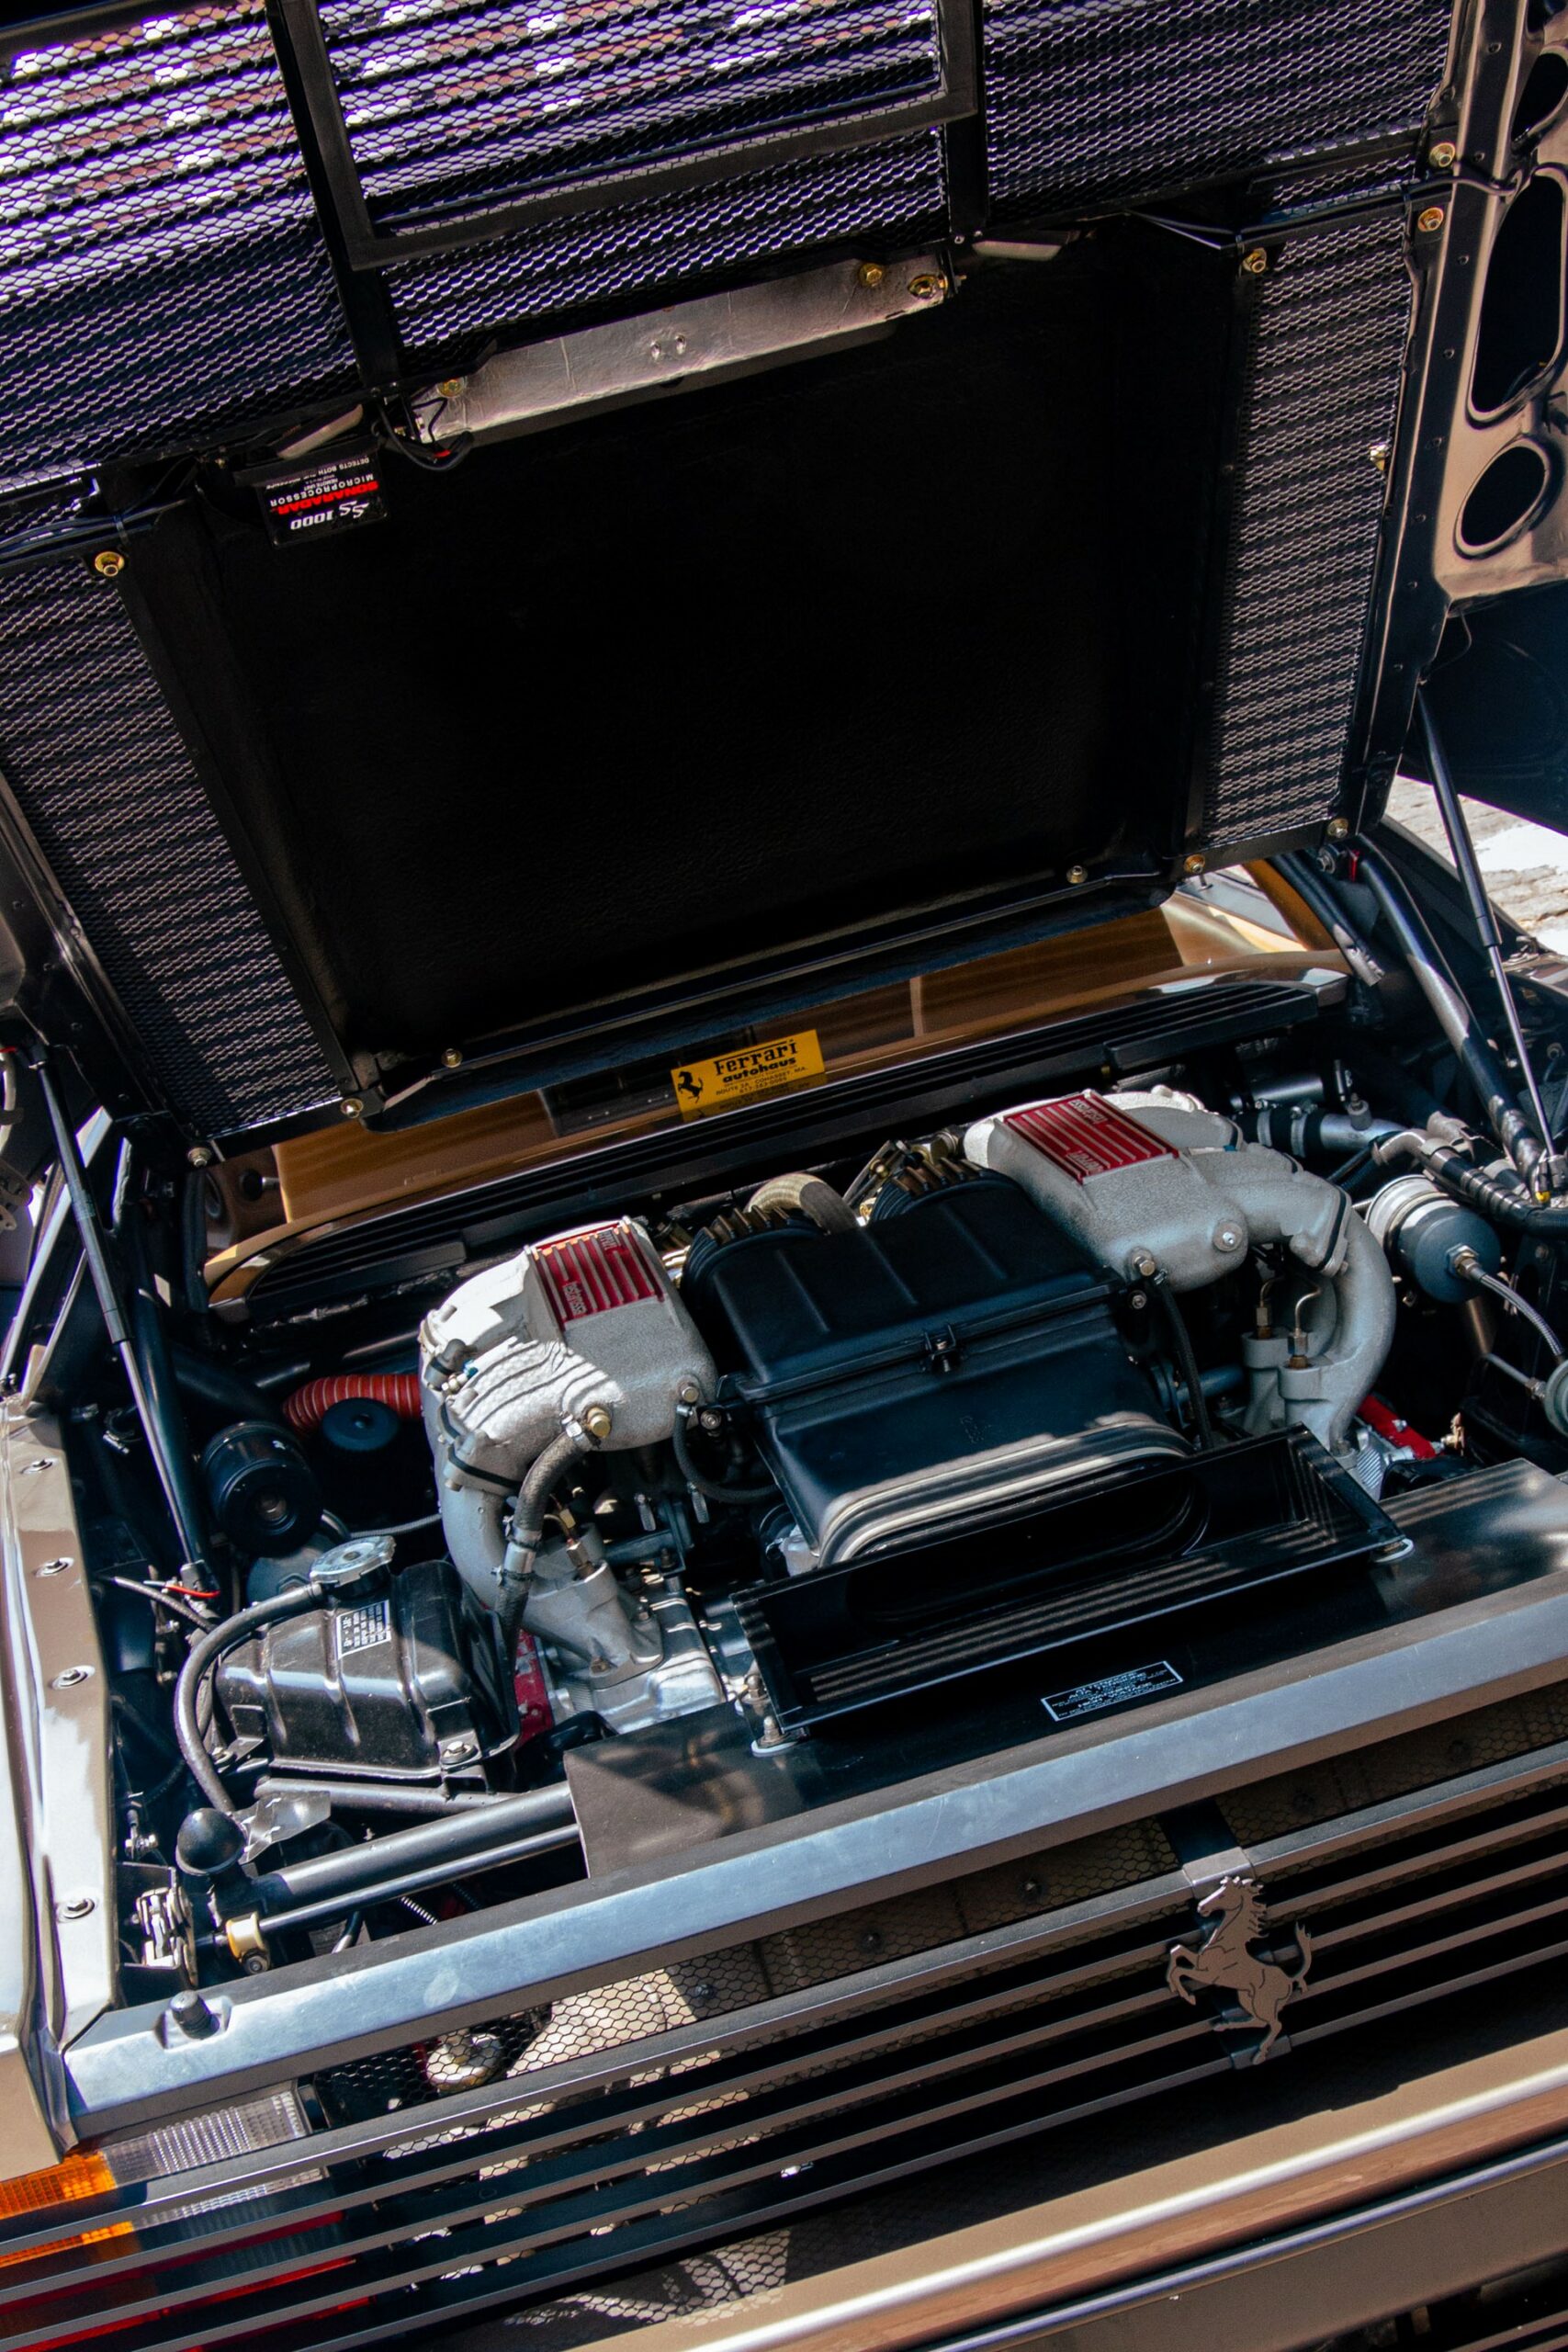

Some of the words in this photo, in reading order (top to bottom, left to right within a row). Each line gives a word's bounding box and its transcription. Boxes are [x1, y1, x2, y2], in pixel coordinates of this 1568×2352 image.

[318, 465, 337, 476] BOTH
[339, 458, 370, 470] DETECTS
[270, 473, 374, 507] MICROPROCESSOR
[277, 481, 378, 514] SONARADAR
[290, 509, 334, 530] 1000
[713, 1039, 798, 1076] Ferrari
[722, 1057, 796, 1083] autohaus
